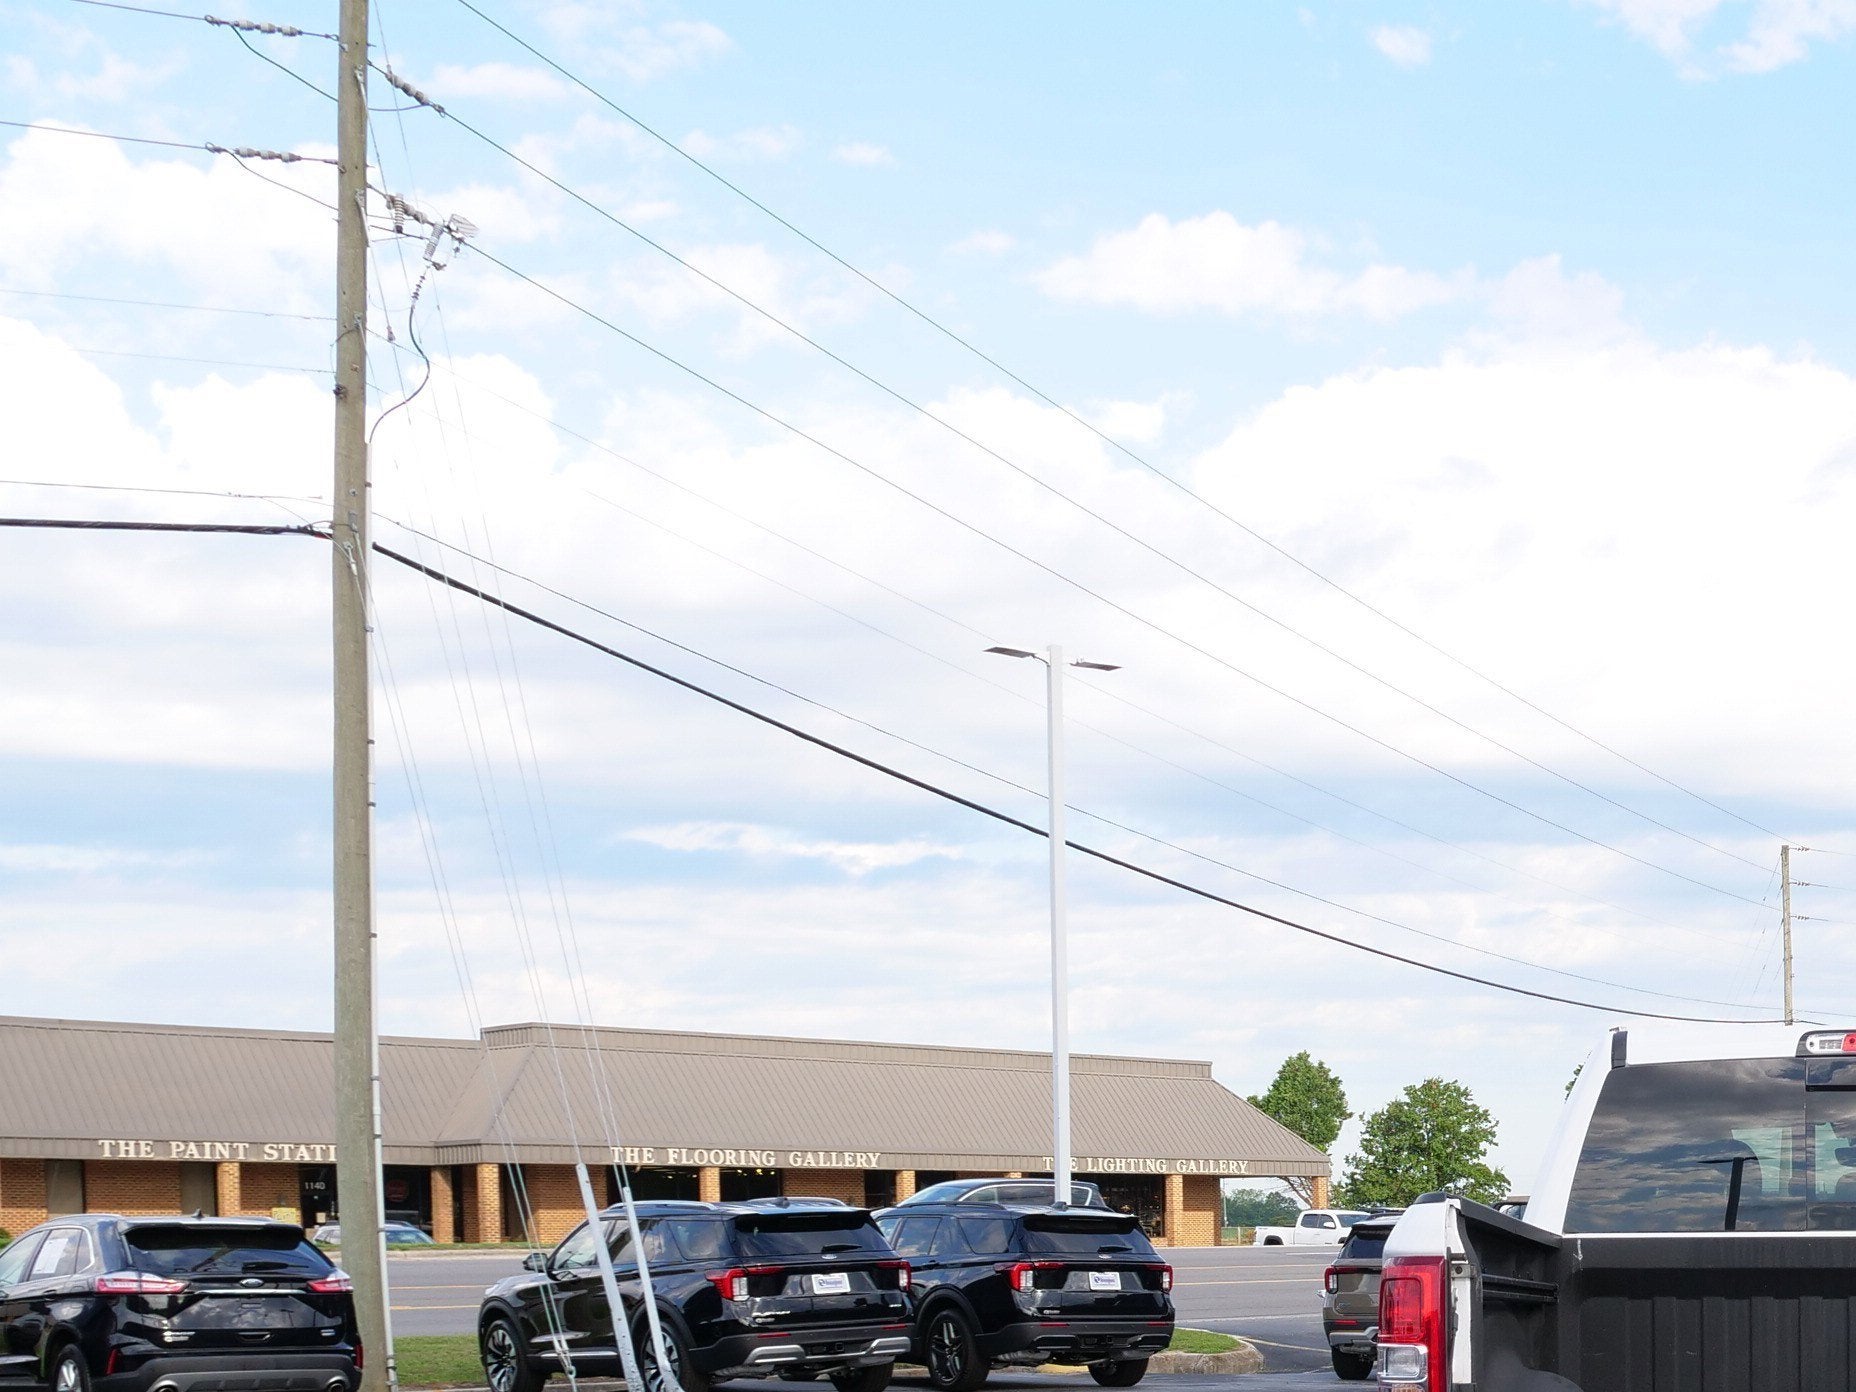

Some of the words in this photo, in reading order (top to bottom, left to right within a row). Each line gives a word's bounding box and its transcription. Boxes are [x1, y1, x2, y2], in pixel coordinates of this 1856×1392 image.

[98, 1140, 155, 1158] THE
[169, 1141, 249, 1160] PAINT
[263, 1143, 337, 1162] STATI
[610, 1146, 655, 1164] THE
[667, 1147, 776, 1167] FLOORING
[789, 1151, 881, 1168] GALLERY
[1042, 1156, 1078, 1171] TE
[1086, 1157, 1167, 1173] LIGHTING
[1176, 1159, 1249, 1174] GALLERY
